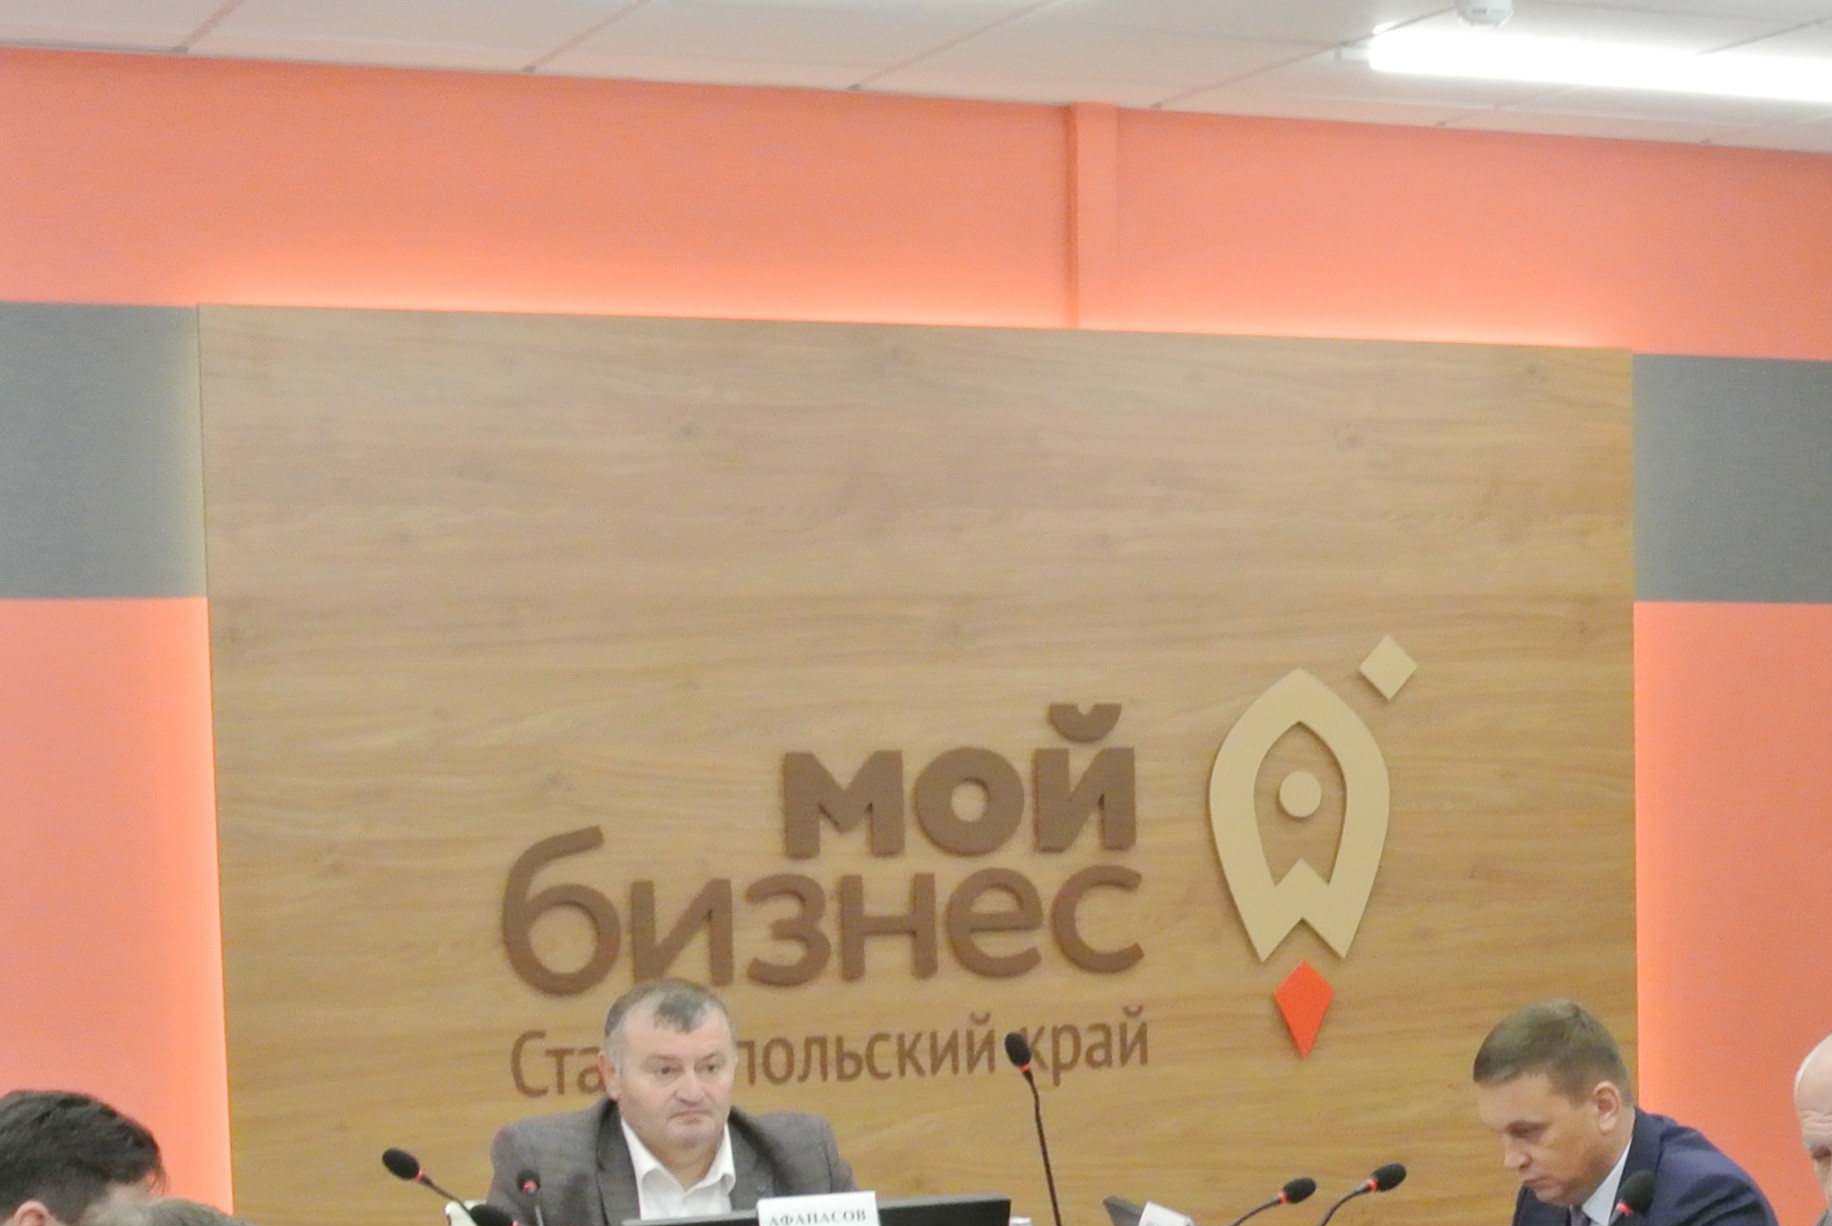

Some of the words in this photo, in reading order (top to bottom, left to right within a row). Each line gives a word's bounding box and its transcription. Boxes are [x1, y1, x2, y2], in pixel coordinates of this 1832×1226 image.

[782, 702, 1137, 860] мой
[501, 824, 1147, 999] бизнес
[510, 1010, 997, 1099] Стапольский
[1018, 1004, 1149, 1088] край
